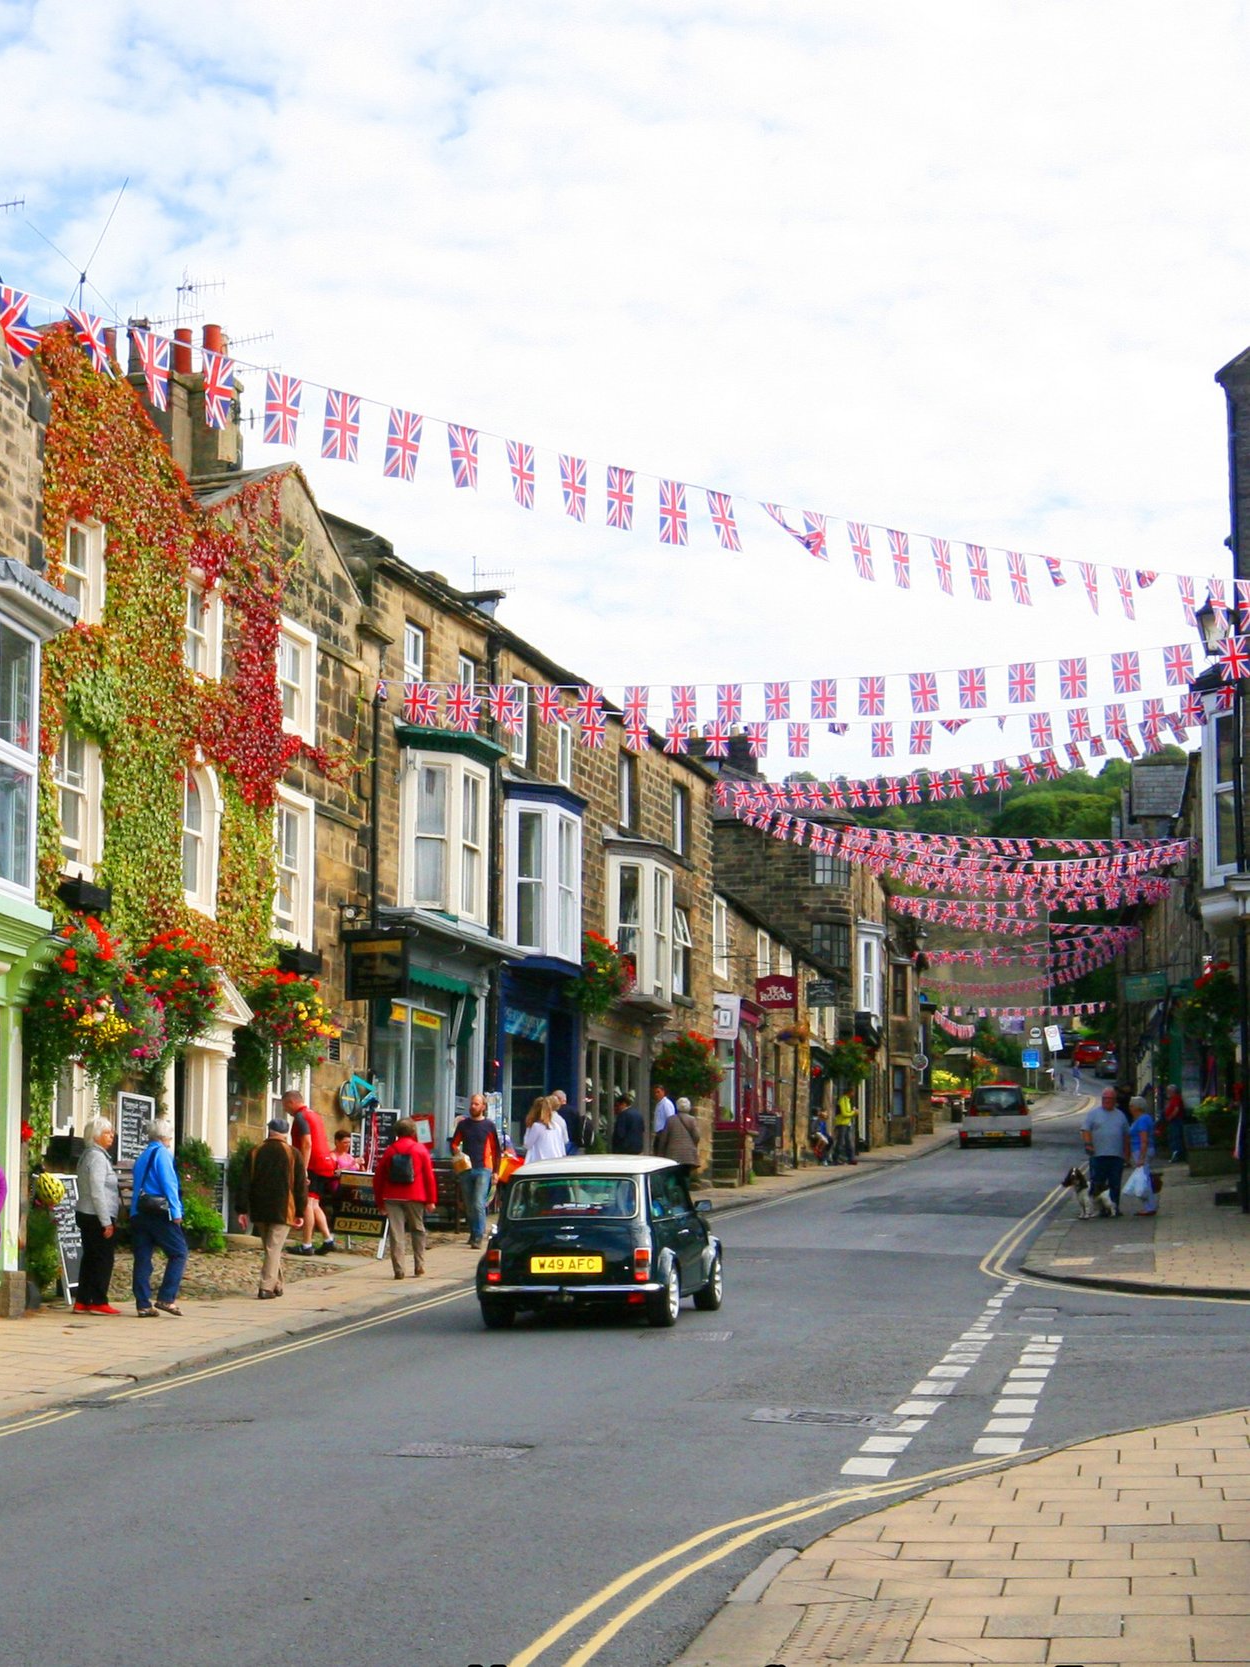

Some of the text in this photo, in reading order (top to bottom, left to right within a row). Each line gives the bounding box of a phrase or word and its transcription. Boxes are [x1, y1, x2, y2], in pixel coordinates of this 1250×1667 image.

[759, 991, 793, 1001] ROOMS
[337, 1219, 379, 1232] OPEN
[539, 1259, 595, 1270] W49 AFC
